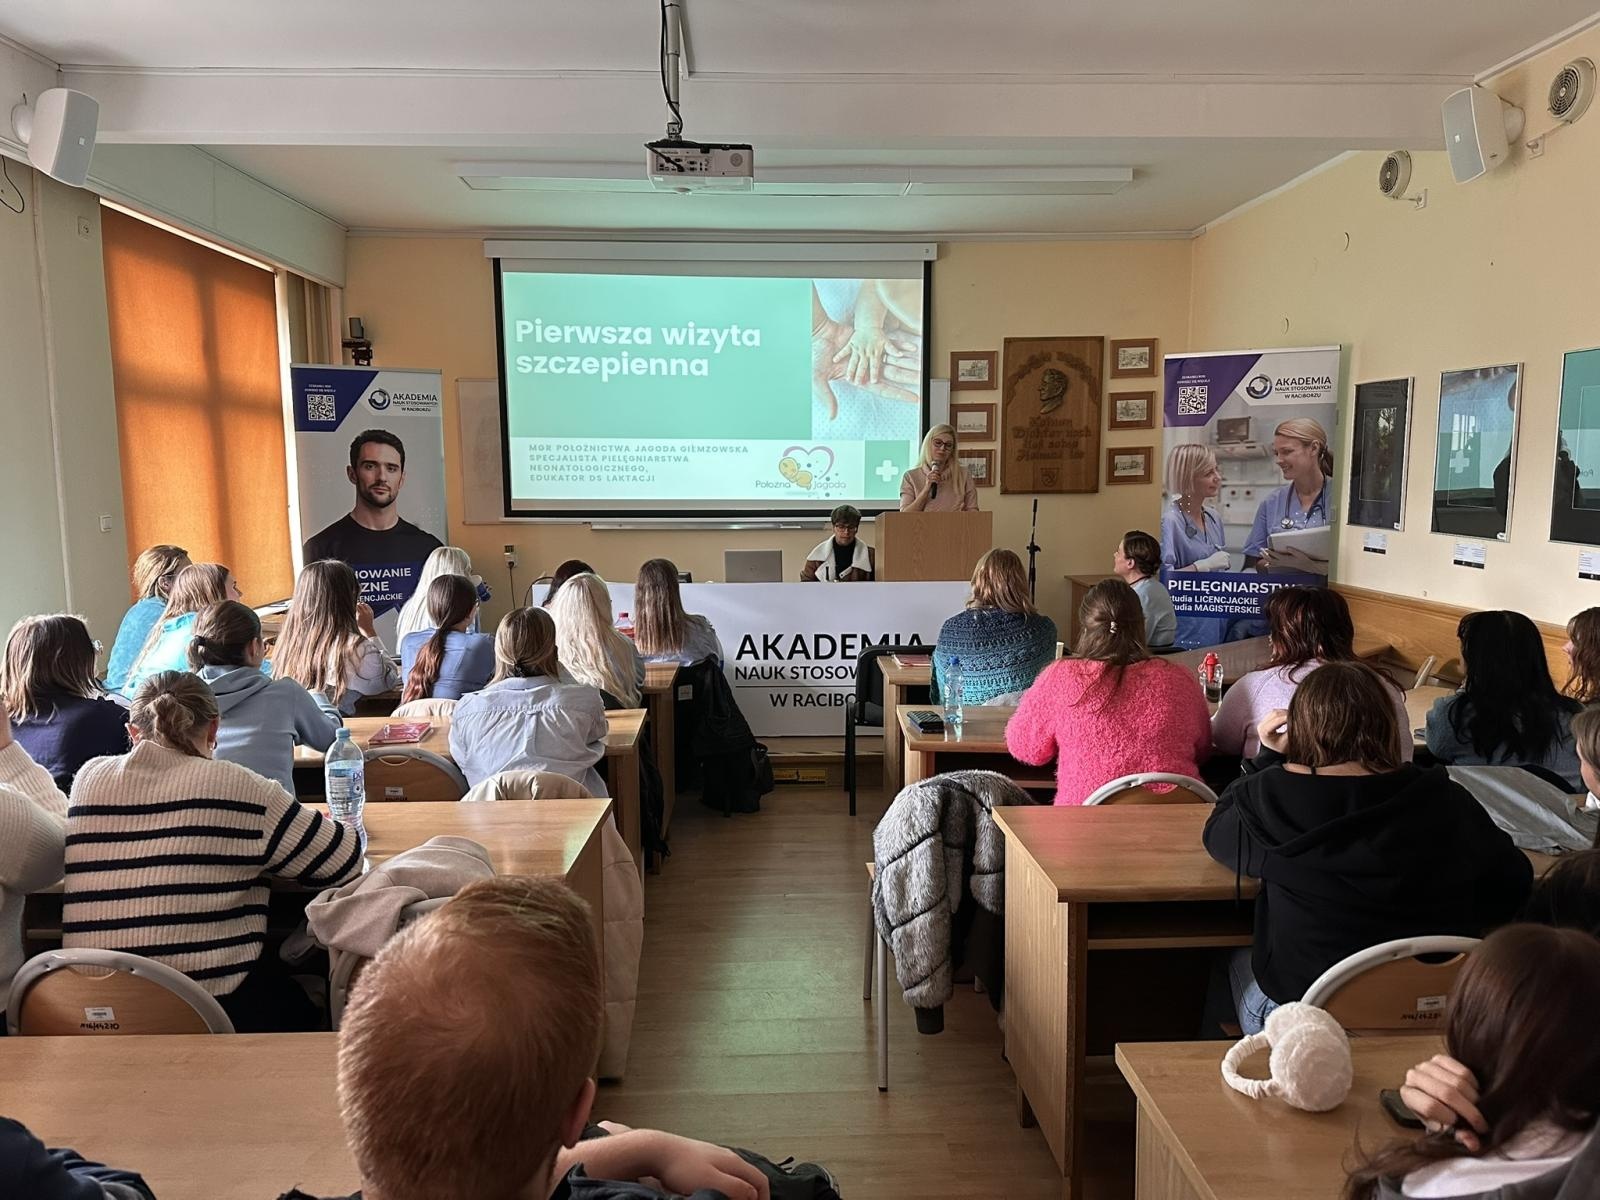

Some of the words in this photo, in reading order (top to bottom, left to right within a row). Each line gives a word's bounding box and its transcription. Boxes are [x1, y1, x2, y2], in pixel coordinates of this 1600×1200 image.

[515, 319, 653, 346] Pierwsza
[661, 322, 761, 354] wizyta
[516, 351, 709, 382] szczepienna
[1275, 376, 1332, 386] AKADEMIA
[392, 393, 438, 402] AKADEMIA
[634, 445, 677, 453] JAGODA
[528, 454, 597, 462] SPECJALISTA
[601, 454, 690, 463] PIELĘGNIARSTWA
[529, 474, 585, 482] EDUKATOR
[589, 474, 602, 482] DS
[606, 475, 655, 483] LAKTACJI
[1168, 579, 1297, 595] PIELĘGNIARST
[1169, 595, 1193, 603] tudia
[1194, 595, 1259, 606] LICENCJACKIE
[1172, 604, 1193, 612] udia
[1194, 604, 1262, 614] MAGISTERSKIE
[735, 665, 786, 680] NAUK
[769, 693, 788, 707] W
